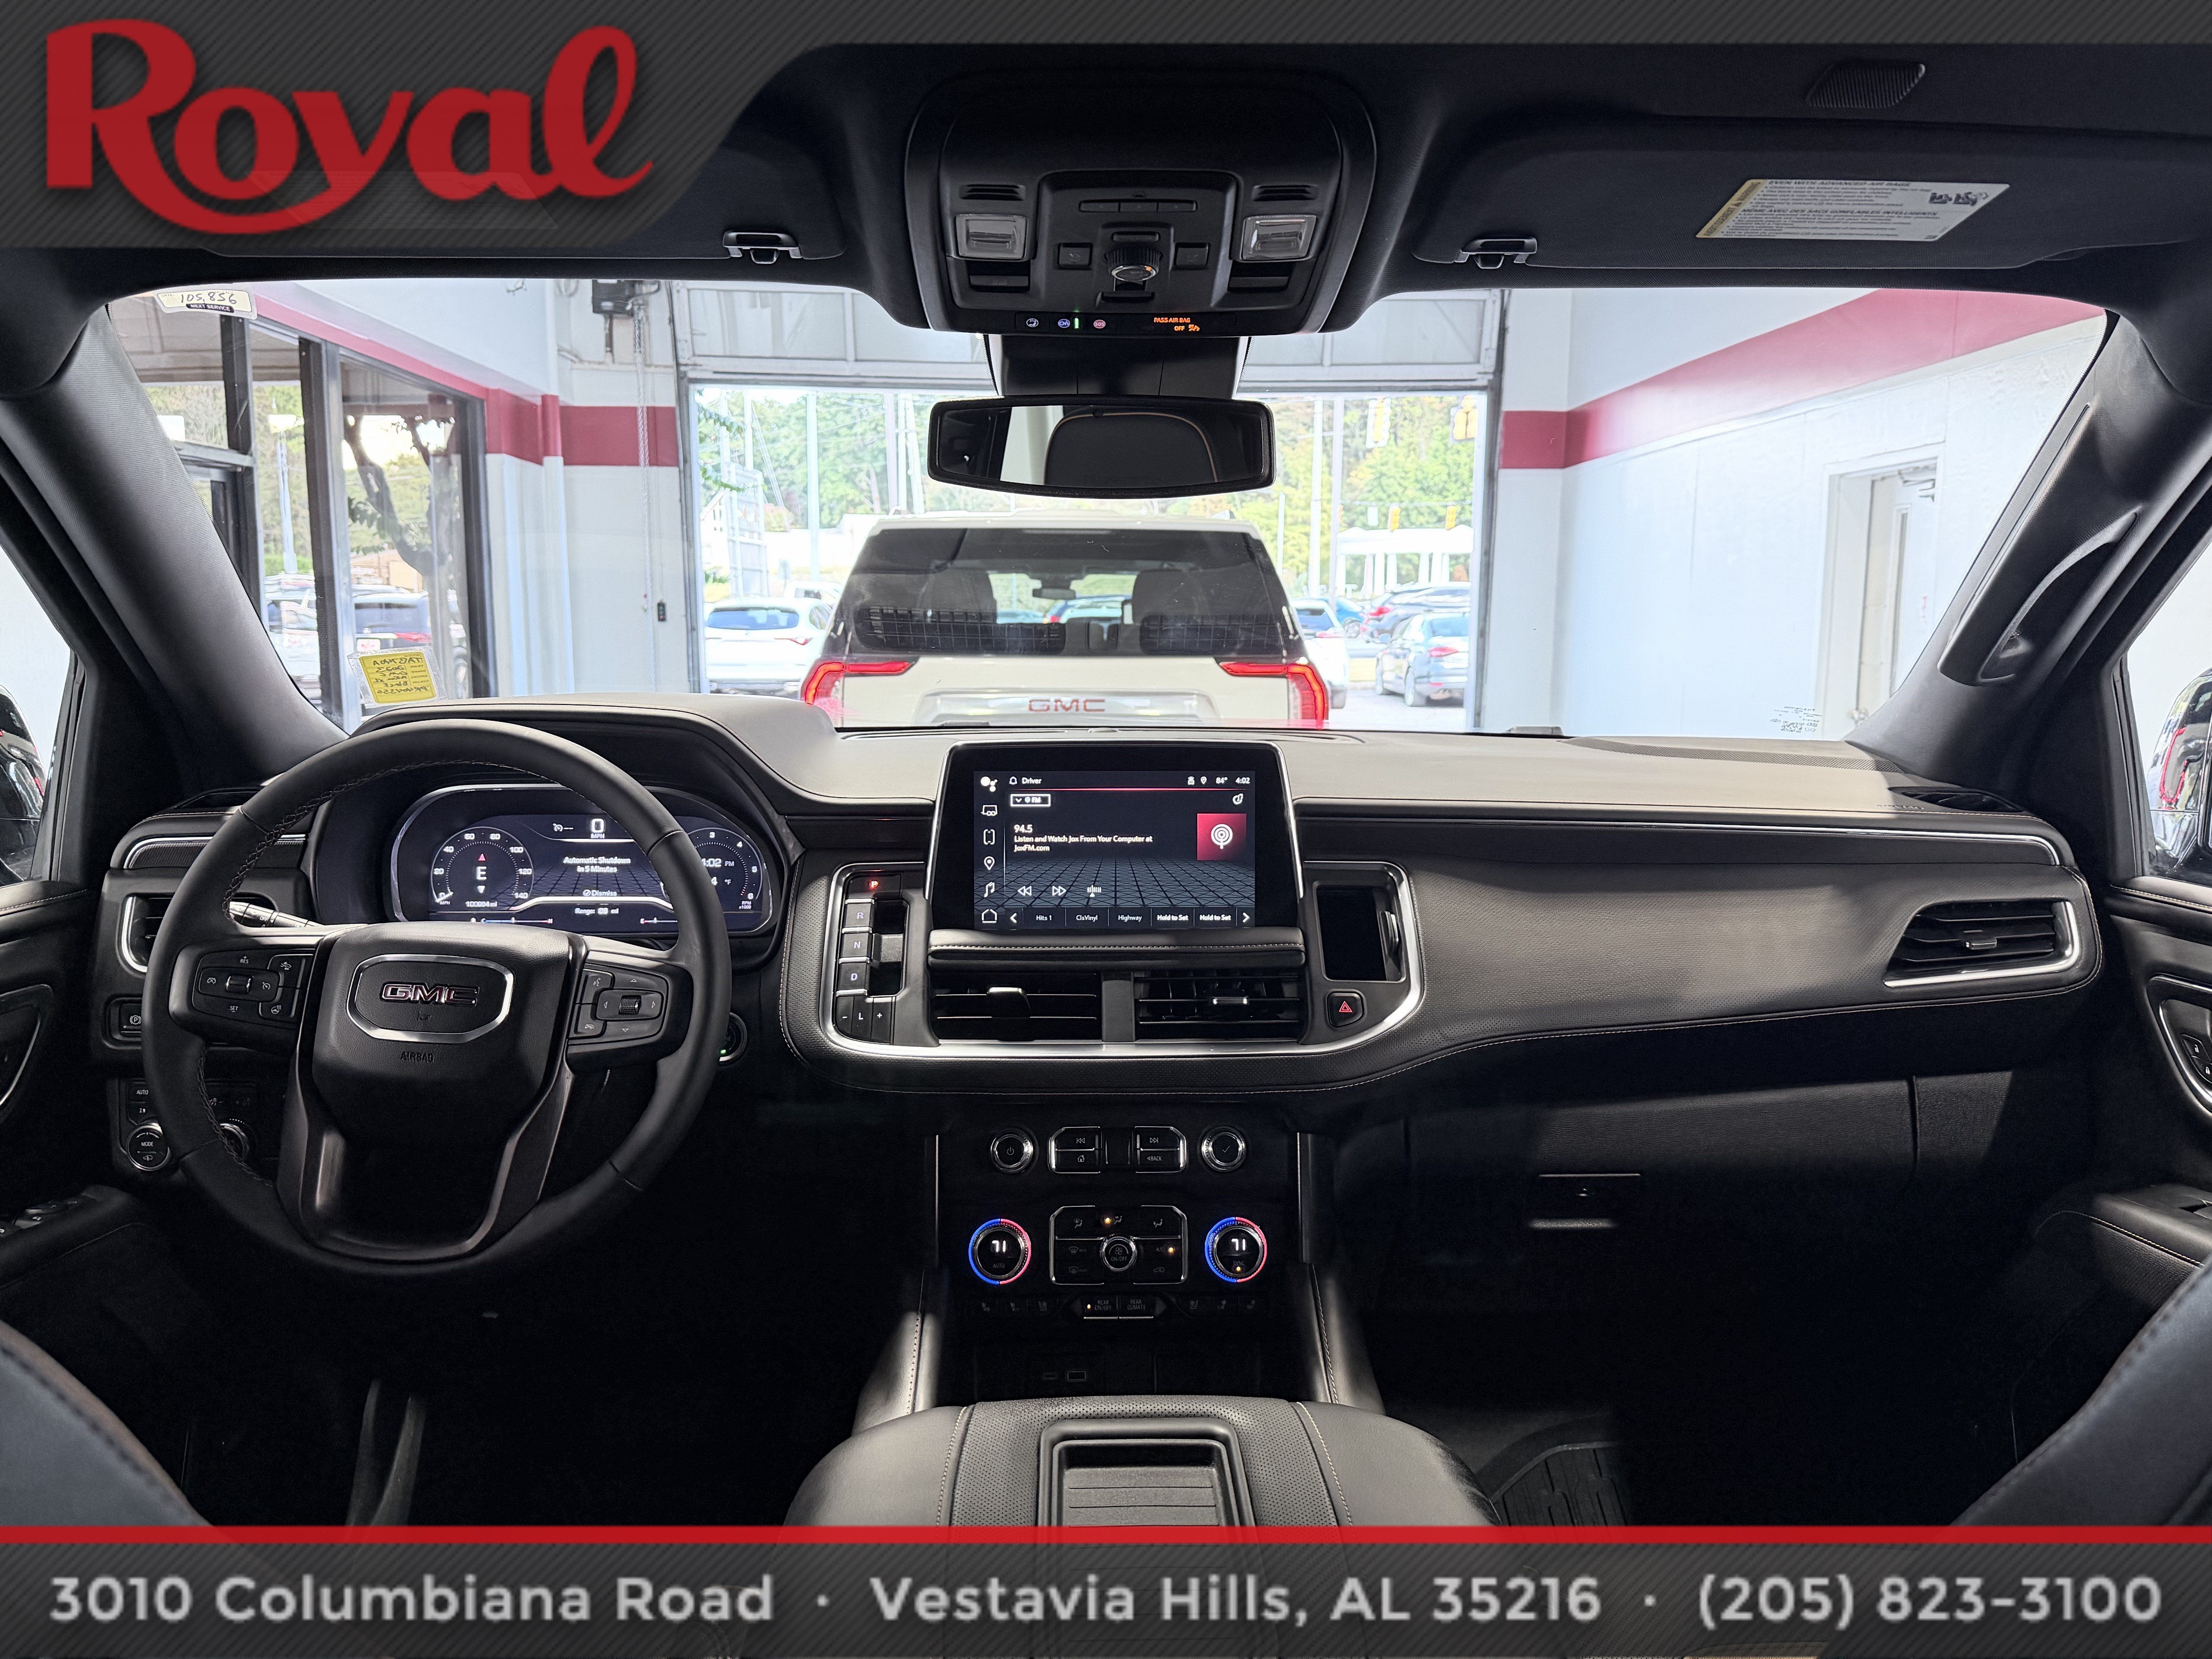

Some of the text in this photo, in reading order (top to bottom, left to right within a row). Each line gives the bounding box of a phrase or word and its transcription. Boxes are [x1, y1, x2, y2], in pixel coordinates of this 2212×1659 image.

[1029, 699, 1105, 712] GMC
[591, 818, 605, 833] 0
[1014, 824, 1033, 833] 94.5
[1113, 835, 1145, 843] Computer
[476, 866, 487, 880] E
[380, 983, 480, 1006] GMC
[992, 1240, 1006, 1252] 71
[1231, 1238, 1246, 1251] 71
